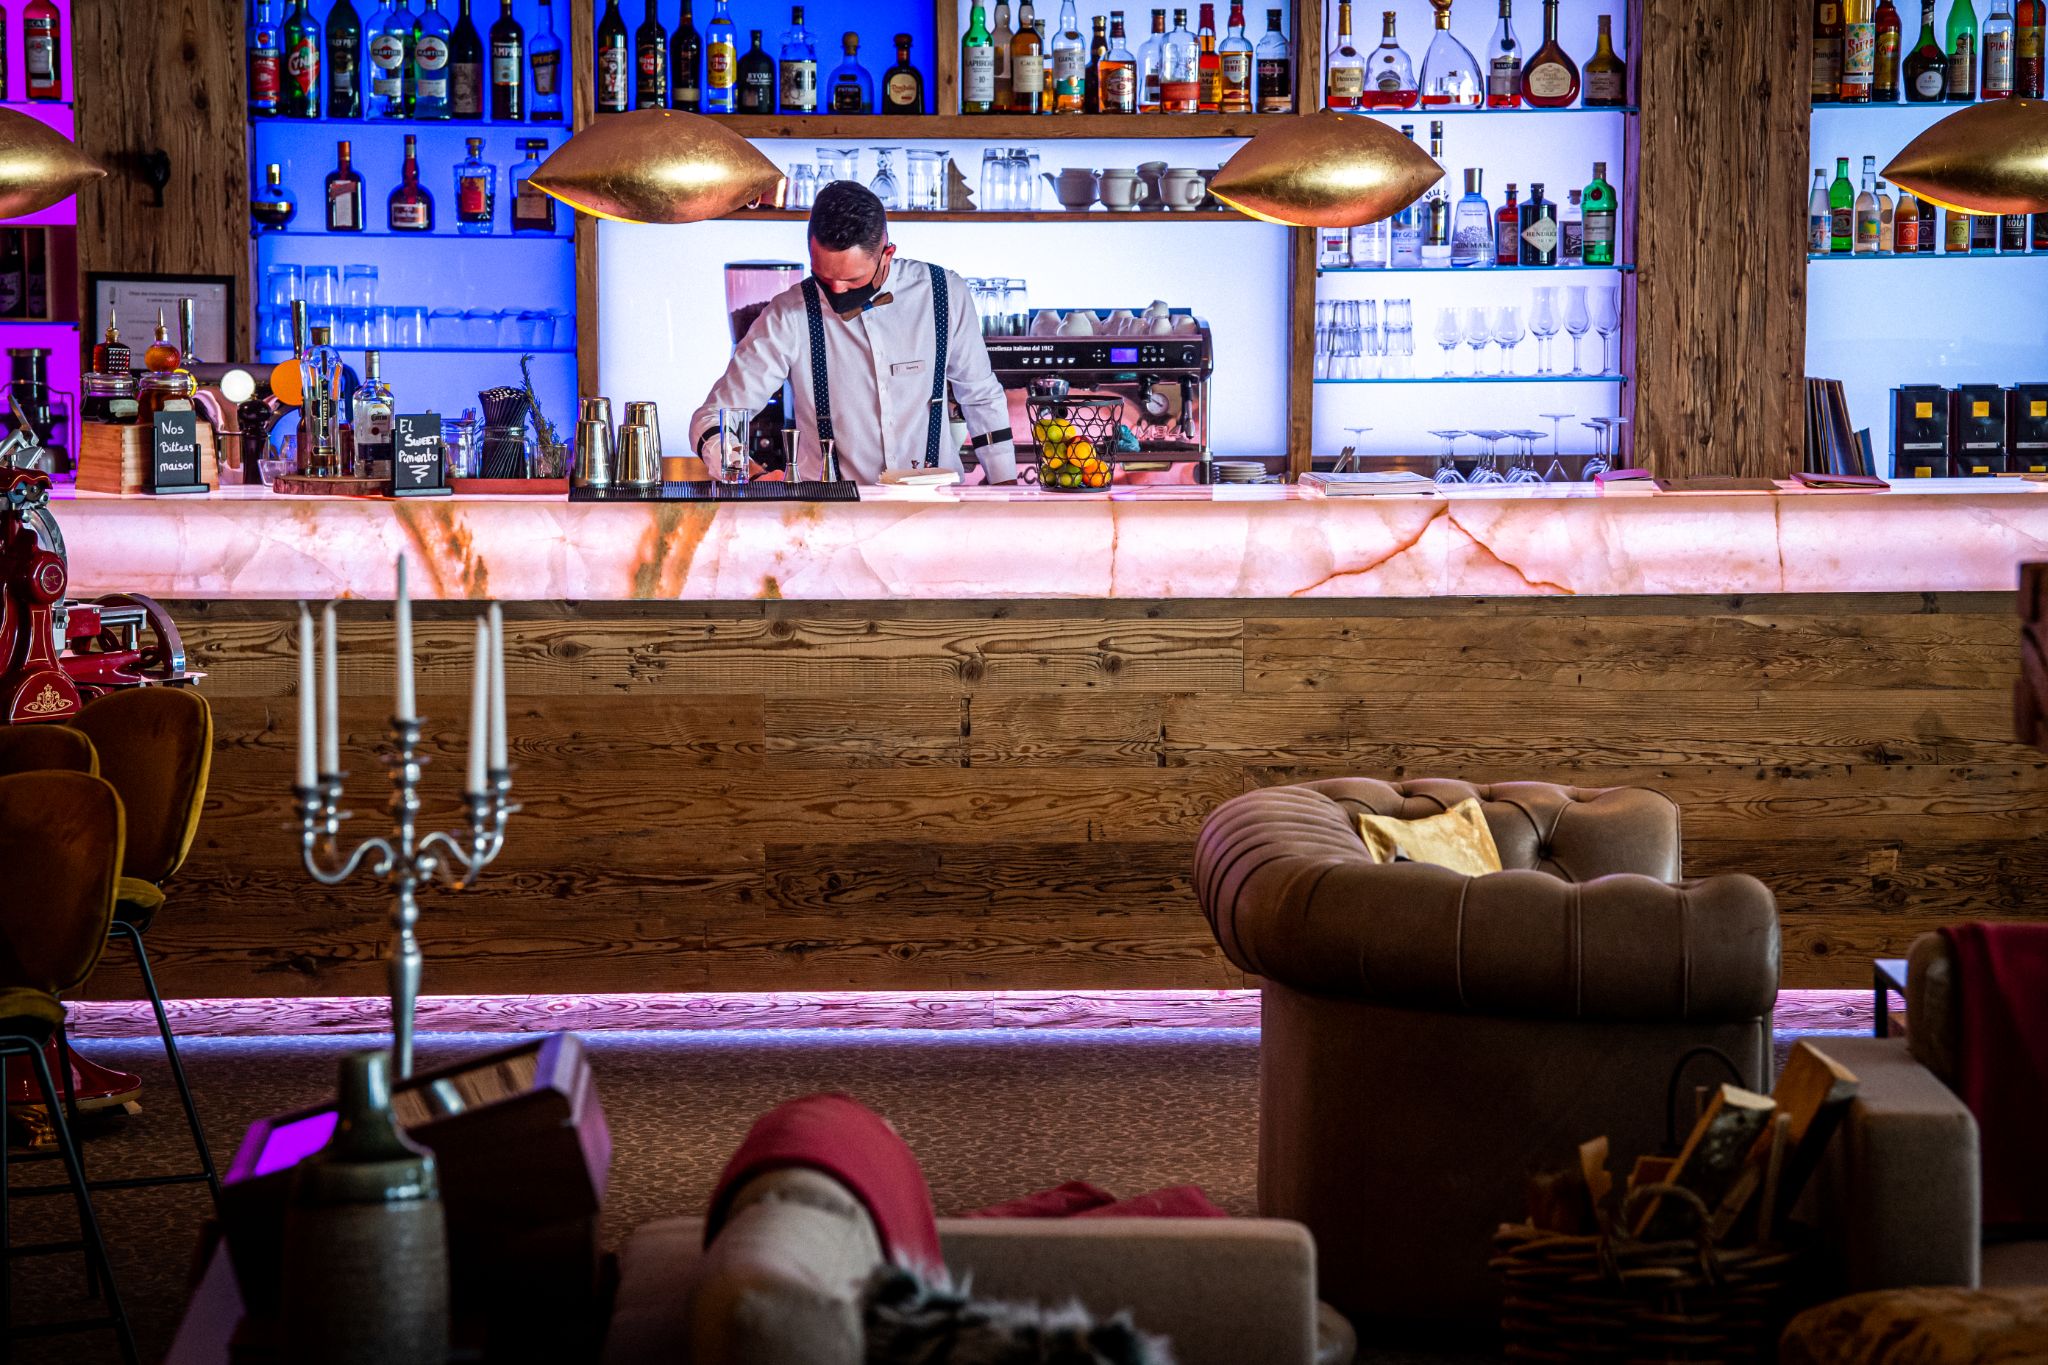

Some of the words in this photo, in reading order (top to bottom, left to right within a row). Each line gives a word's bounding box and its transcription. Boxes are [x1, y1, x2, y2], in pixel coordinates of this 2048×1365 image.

[2006, 219, 2025, 227] KOLA
[161, 420, 185, 435] Nos
[400, 418, 414, 434] El
[160, 441, 194, 453] Bitters
[160, 460, 194, 472] maison
